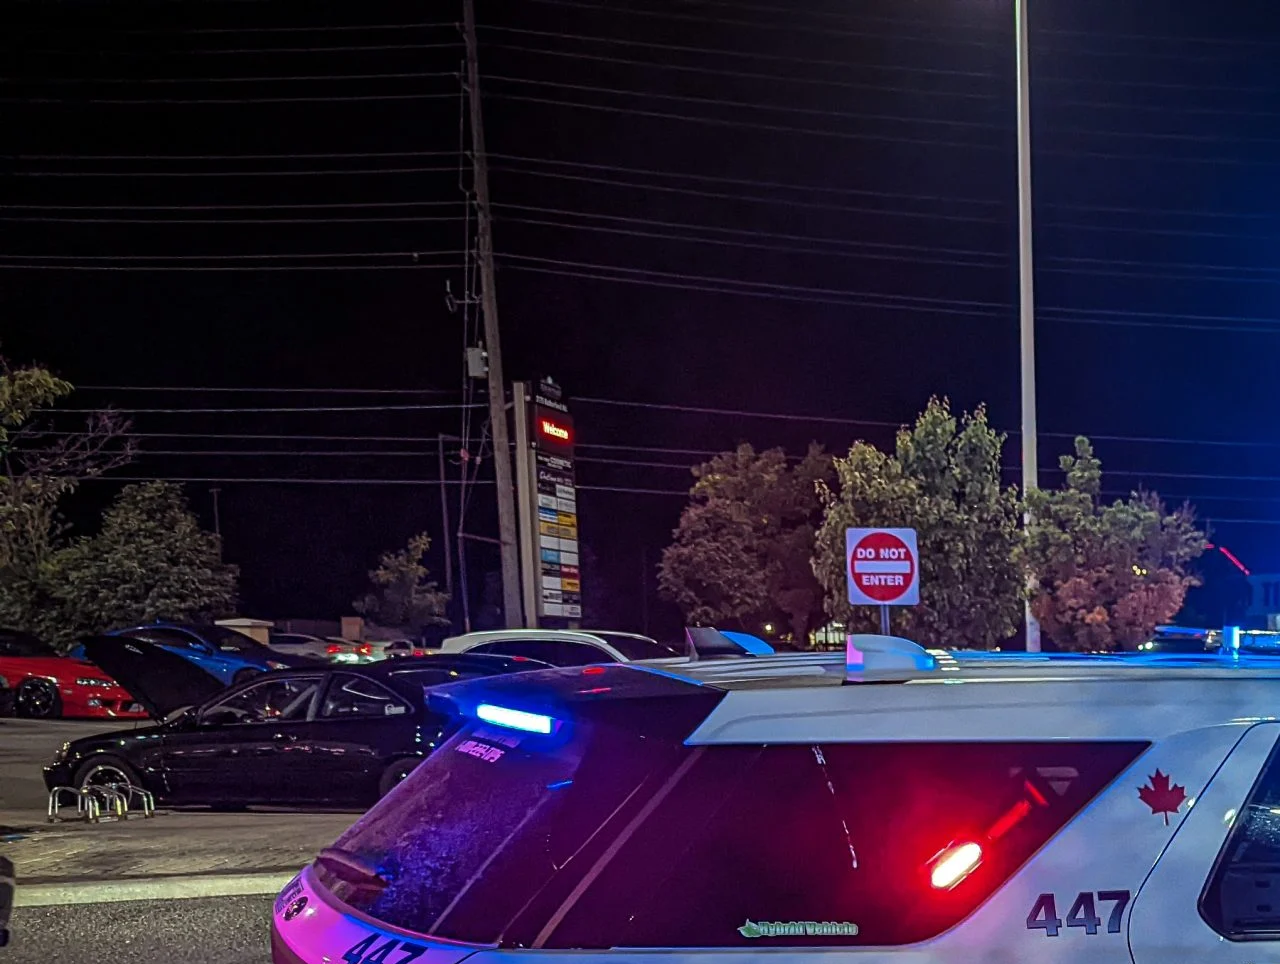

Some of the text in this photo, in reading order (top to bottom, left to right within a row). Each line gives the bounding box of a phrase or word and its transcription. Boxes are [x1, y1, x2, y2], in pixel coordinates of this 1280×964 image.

[543, 421, 568, 440] Welcome
[856, 547, 906, 559] DO NOT
[862, 574, 904, 586] ENTER
[1026, 889, 1131, 937] 447
[758, 921, 805, 936] Hybrid
